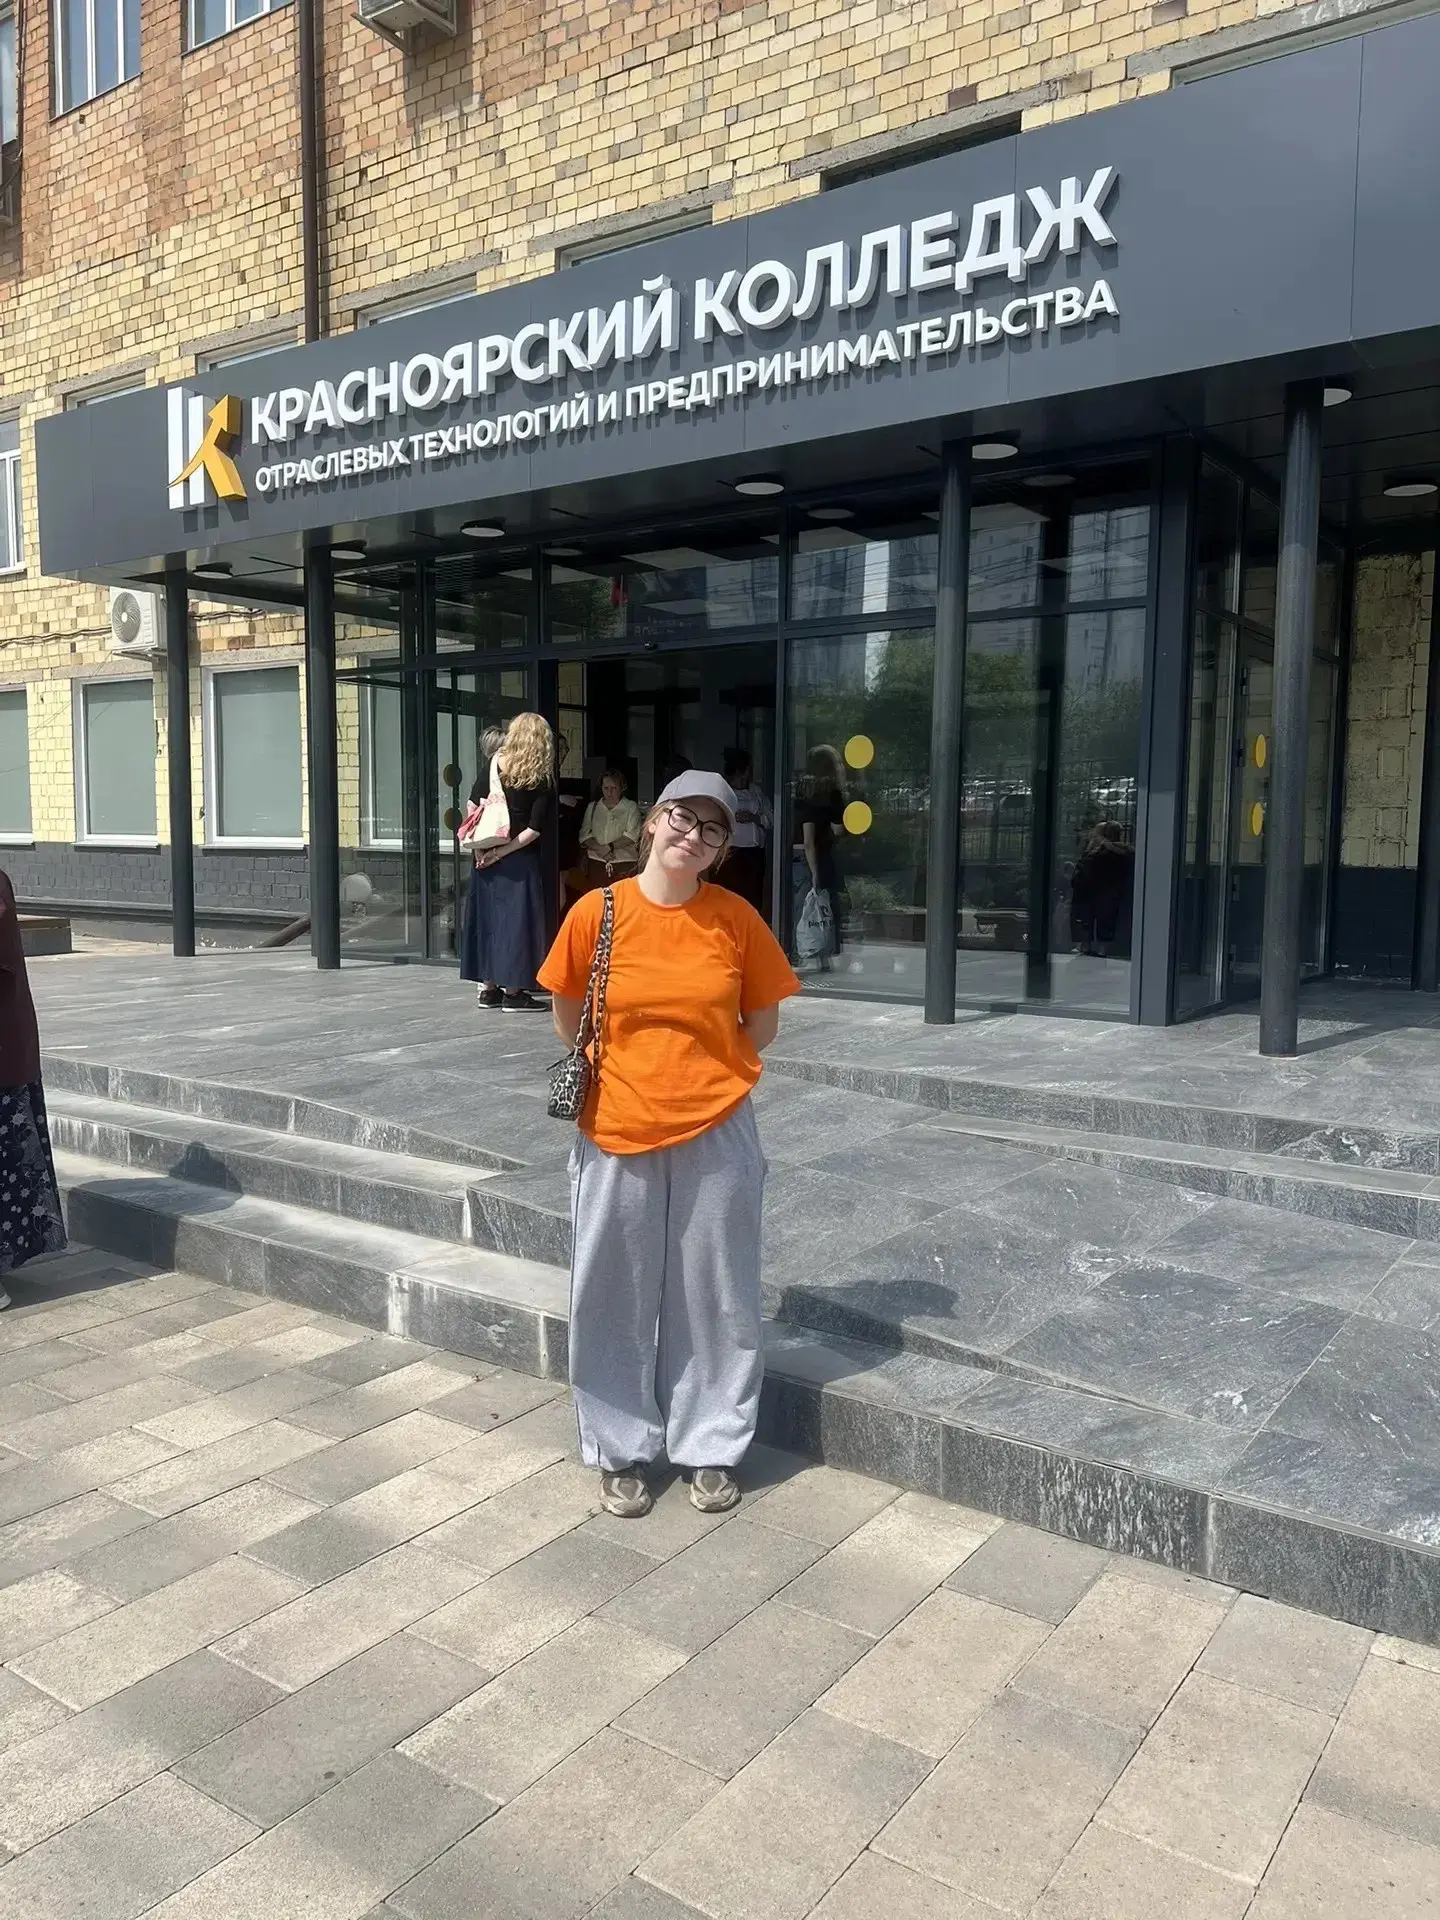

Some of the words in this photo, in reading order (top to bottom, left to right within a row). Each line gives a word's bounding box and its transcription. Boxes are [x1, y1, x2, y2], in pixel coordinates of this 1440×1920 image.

[251, 275, 680, 445] КРАСНОЯРСКИЙ
[693, 166, 1118, 343] КОЛЛЕДЖ
[255, 437, 409, 492] ОТРАСЛЕВЫХ
[409, 390, 594, 461] ТЕХНОЛОГИЙ
[597, 391, 622, 423] И
[625, 279, 1119, 418] ПРЕДПРИНИМАТЕЛЬСТВА
